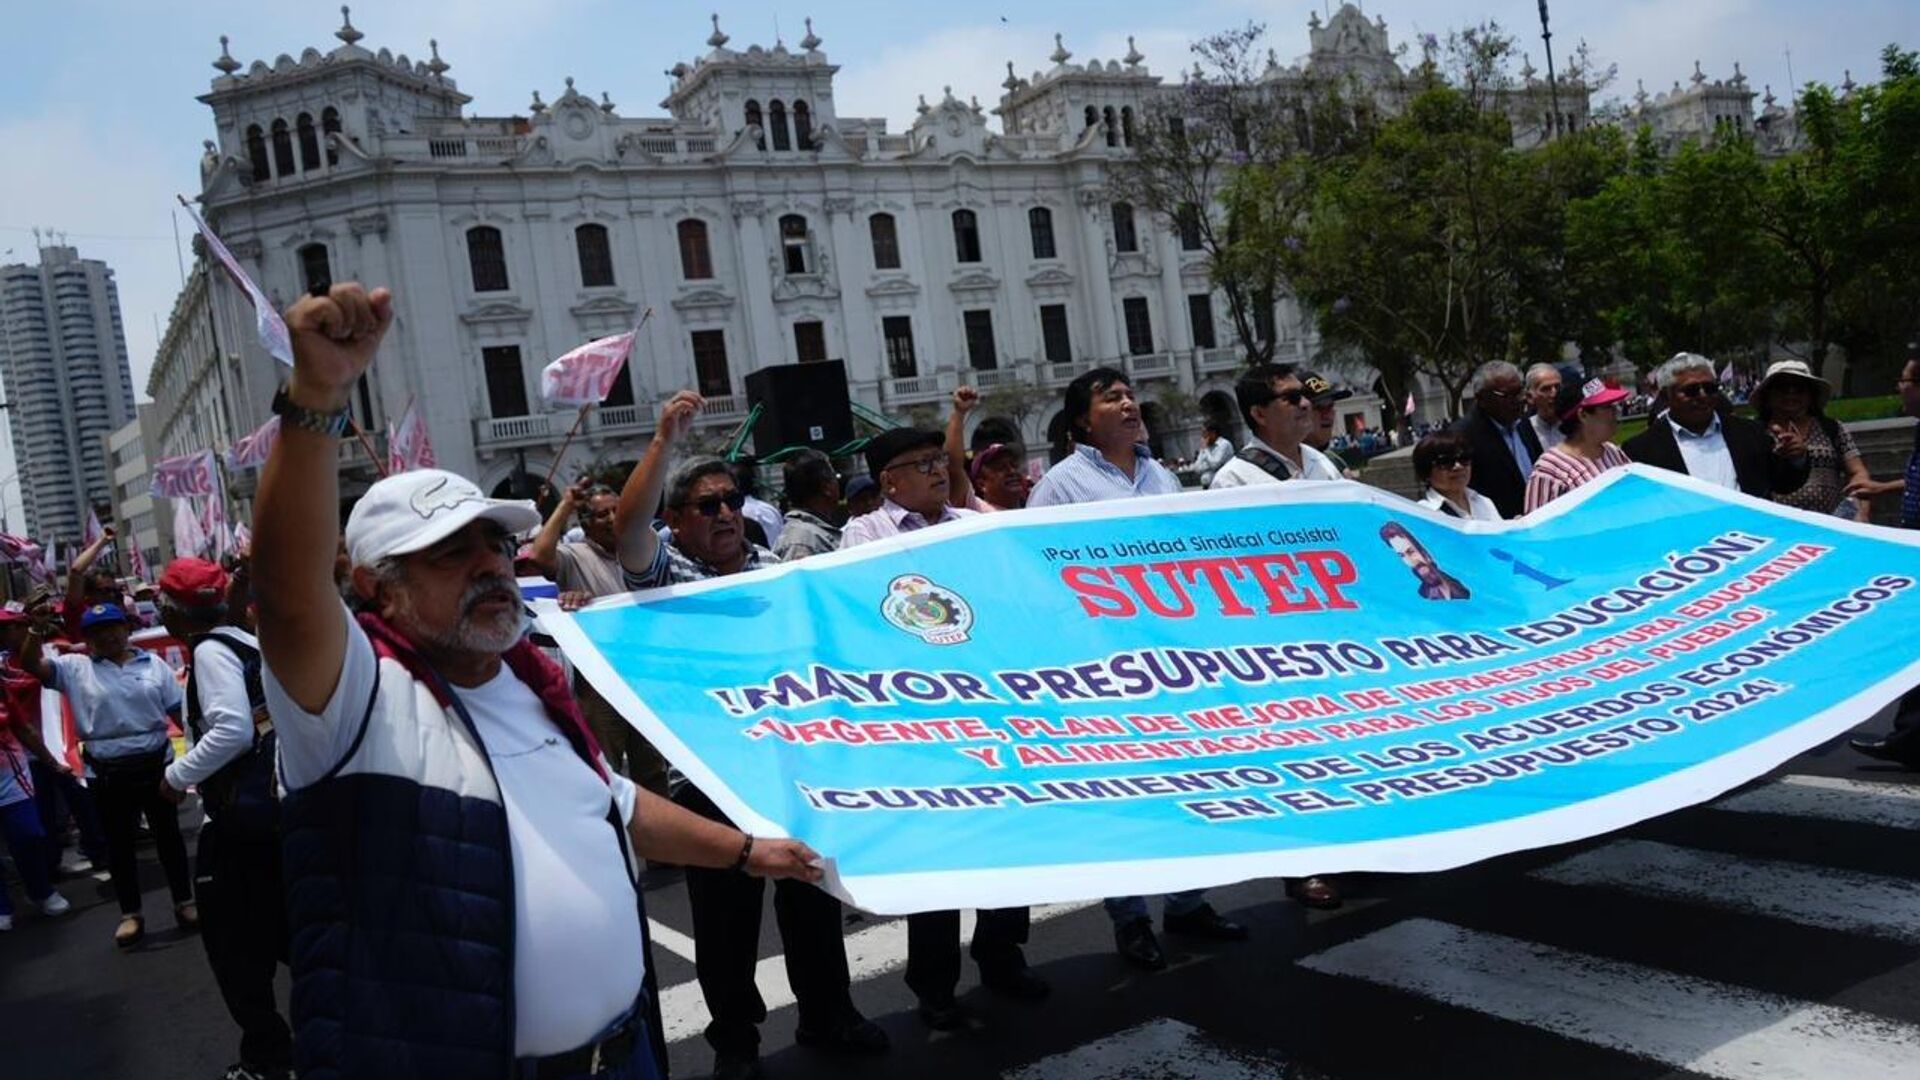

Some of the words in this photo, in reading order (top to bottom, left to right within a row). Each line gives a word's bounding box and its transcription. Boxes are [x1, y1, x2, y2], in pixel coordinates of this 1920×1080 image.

[1061, 551, 1358, 618] SUTEP
[1085, 545, 1109, 559] la
[1111, 538, 1186, 557] Unidad
[1189, 531, 1264, 551] Sindical
[1267, 527, 1340, 546] Clasista!
[999, 642, 1385, 701] PRESUPUESTO
[1382, 633, 1520, 666] PARA
[1006, 717, 1127, 736] PLAN
[1126, 715, 1190, 733] DE
[1187, 696, 1349, 730] MEJORA
[1344, 689, 1401, 711] DE
[1399, 617, 1686, 702] INFRAESTRUCTURA
[1677, 544, 1828, 619] EDUCATIVA
[1282, 757, 1364, 781] DE
[1357, 740, 1460, 769] LOS
[1461, 683, 1687, 750] ACUERDOS
[1677, 574, 1913, 687] ECONÓMICOS
[962, 748, 1001, 768] Y
[1015, 728, 1324, 767] ALIMENTACIÓN
[1320, 713, 1425, 739] PARA
[1419, 700, 1494, 722] LOS
[1488, 676, 1594, 707] HIJOS
[1587, 655, 1656, 681] DEL
[1185, 799, 1277, 820] EN
[1274, 791, 1356, 812] EL
[1350, 717, 1680, 803] PRESUPUESTO
